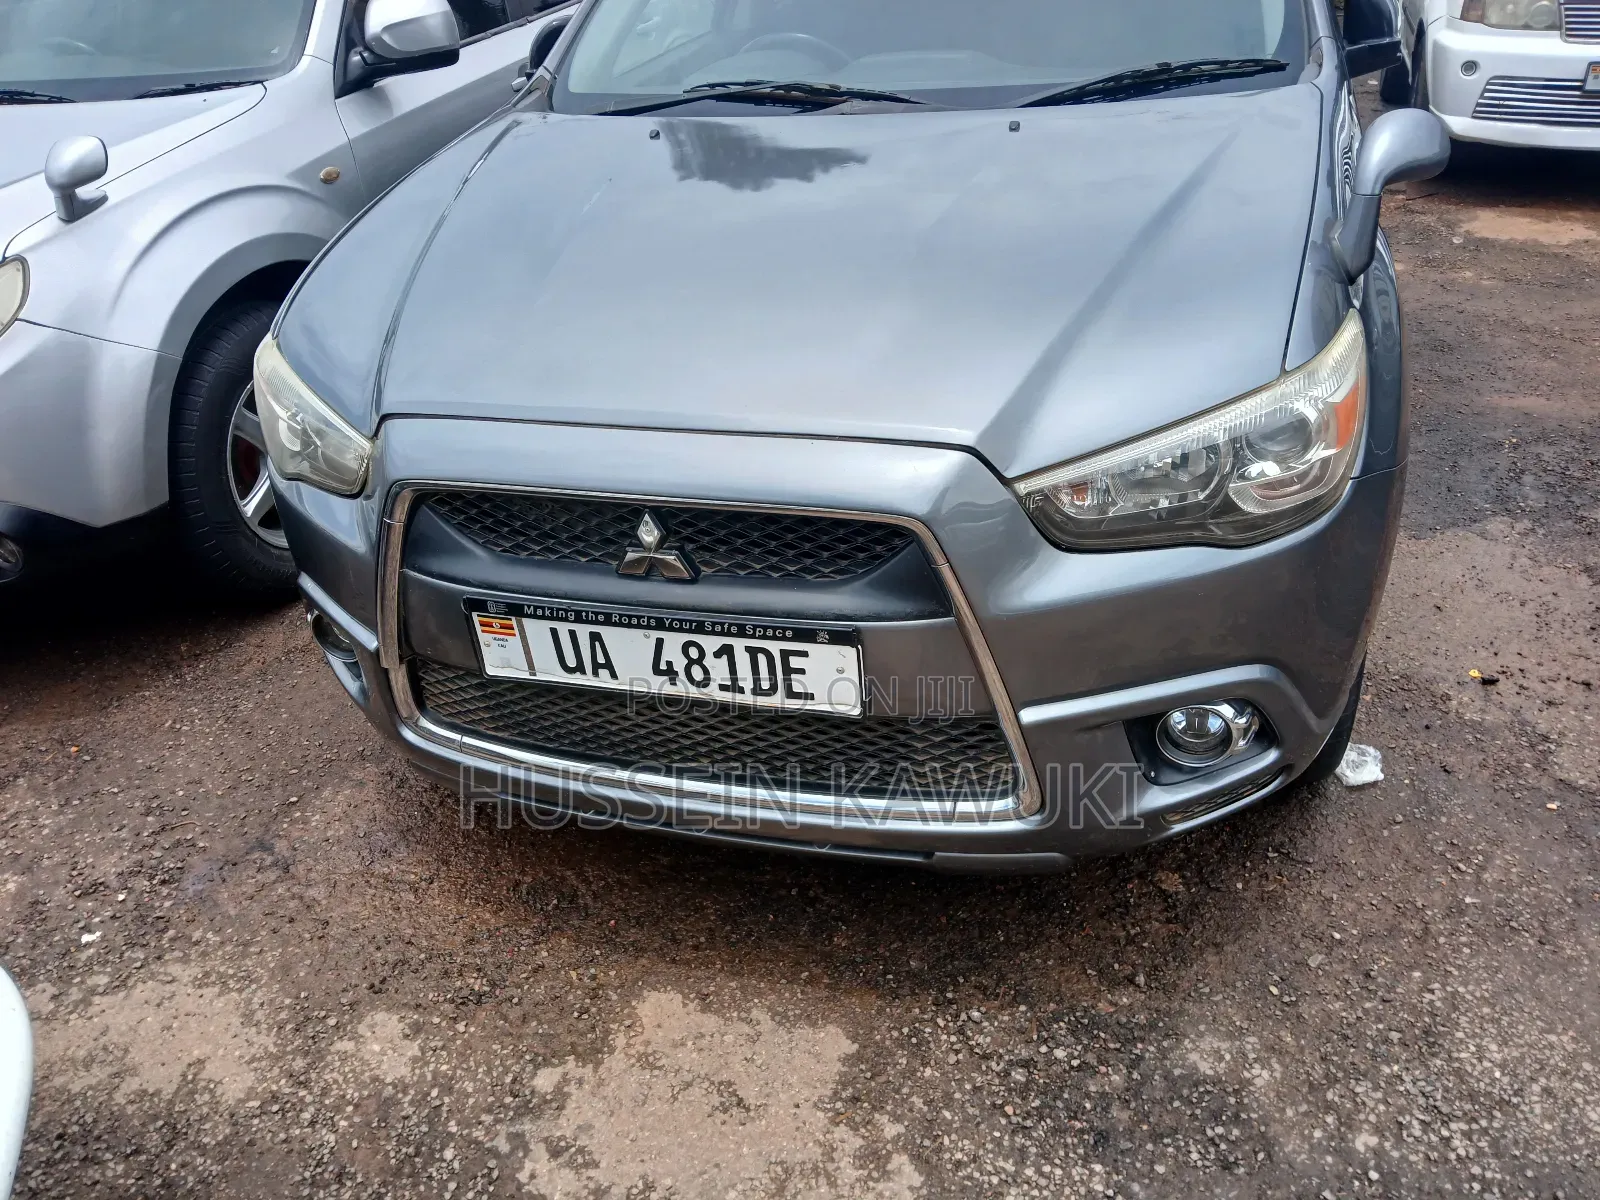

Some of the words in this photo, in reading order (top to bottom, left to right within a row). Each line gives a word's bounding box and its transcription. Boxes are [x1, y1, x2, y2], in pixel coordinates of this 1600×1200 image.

[524, 606, 575, 621] Making
[582, 611, 604, 623] the
[612, 614, 656, 628] Roads
[663, 617, 698, 630] Your
[704, 621, 740, 634] Safe
[745, 625, 794, 639] Space
[549, 626, 619, 680] UA
[651, 637, 815, 701] 481DE
